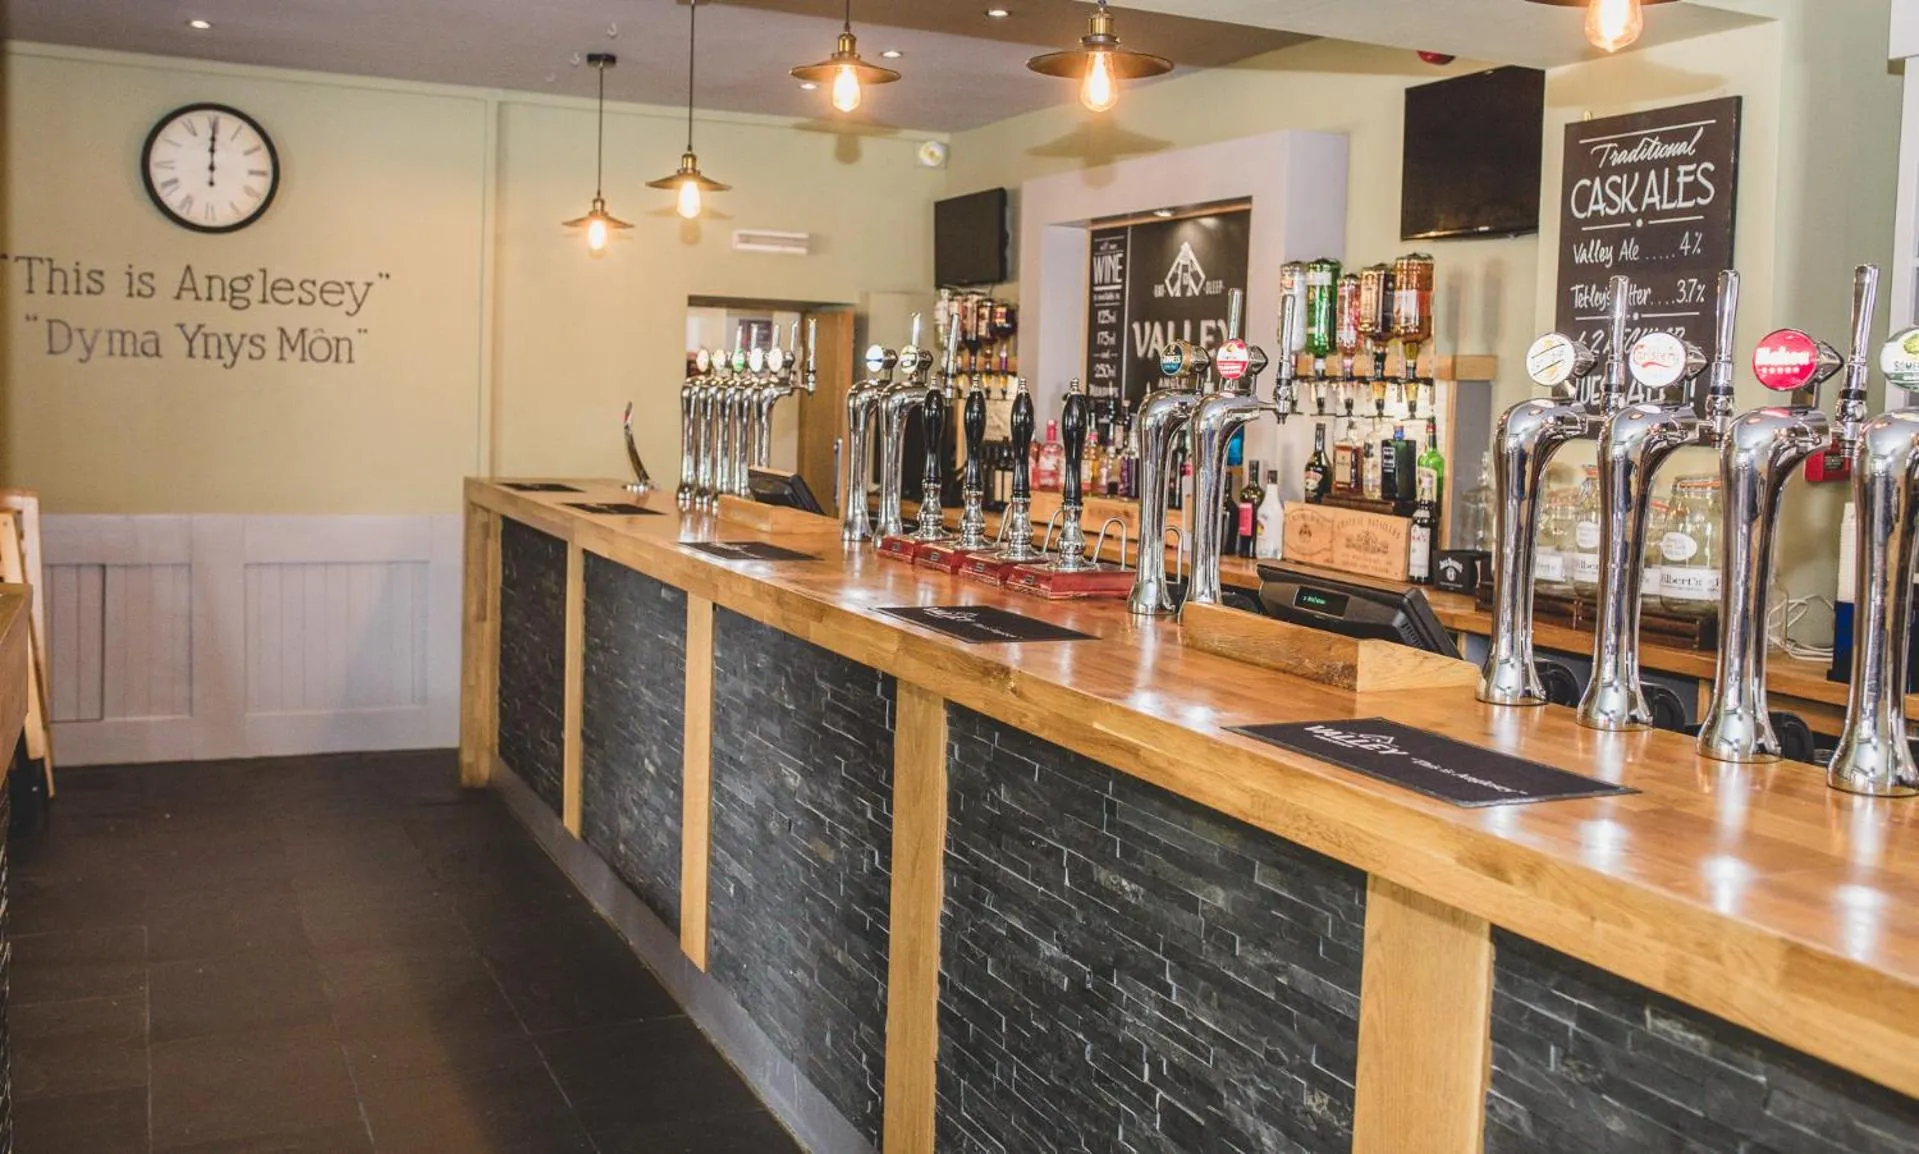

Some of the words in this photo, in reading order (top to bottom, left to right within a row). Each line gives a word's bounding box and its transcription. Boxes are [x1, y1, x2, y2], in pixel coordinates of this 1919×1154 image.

[1591, 126, 1704, 169] Traditional
[1570, 171, 1639, 219] CASK
[1641, 162, 1716, 212] ALES
[1093, 253, 1123, 285] WINE
[1573, 238, 1613, 269] Valley
[1618, 237, 1640, 261] Ale
[1679, 231, 1703, 256] 4%
[125, 263, 156, 299] is
[173, 264, 391, 317] Anglesey"
[24, 314, 163, 364] "Dyma
[175, 323, 267, 369] Ynys
[277, 326, 368, 365] Môn"
[1303, 725, 1410, 756] VALLEY
